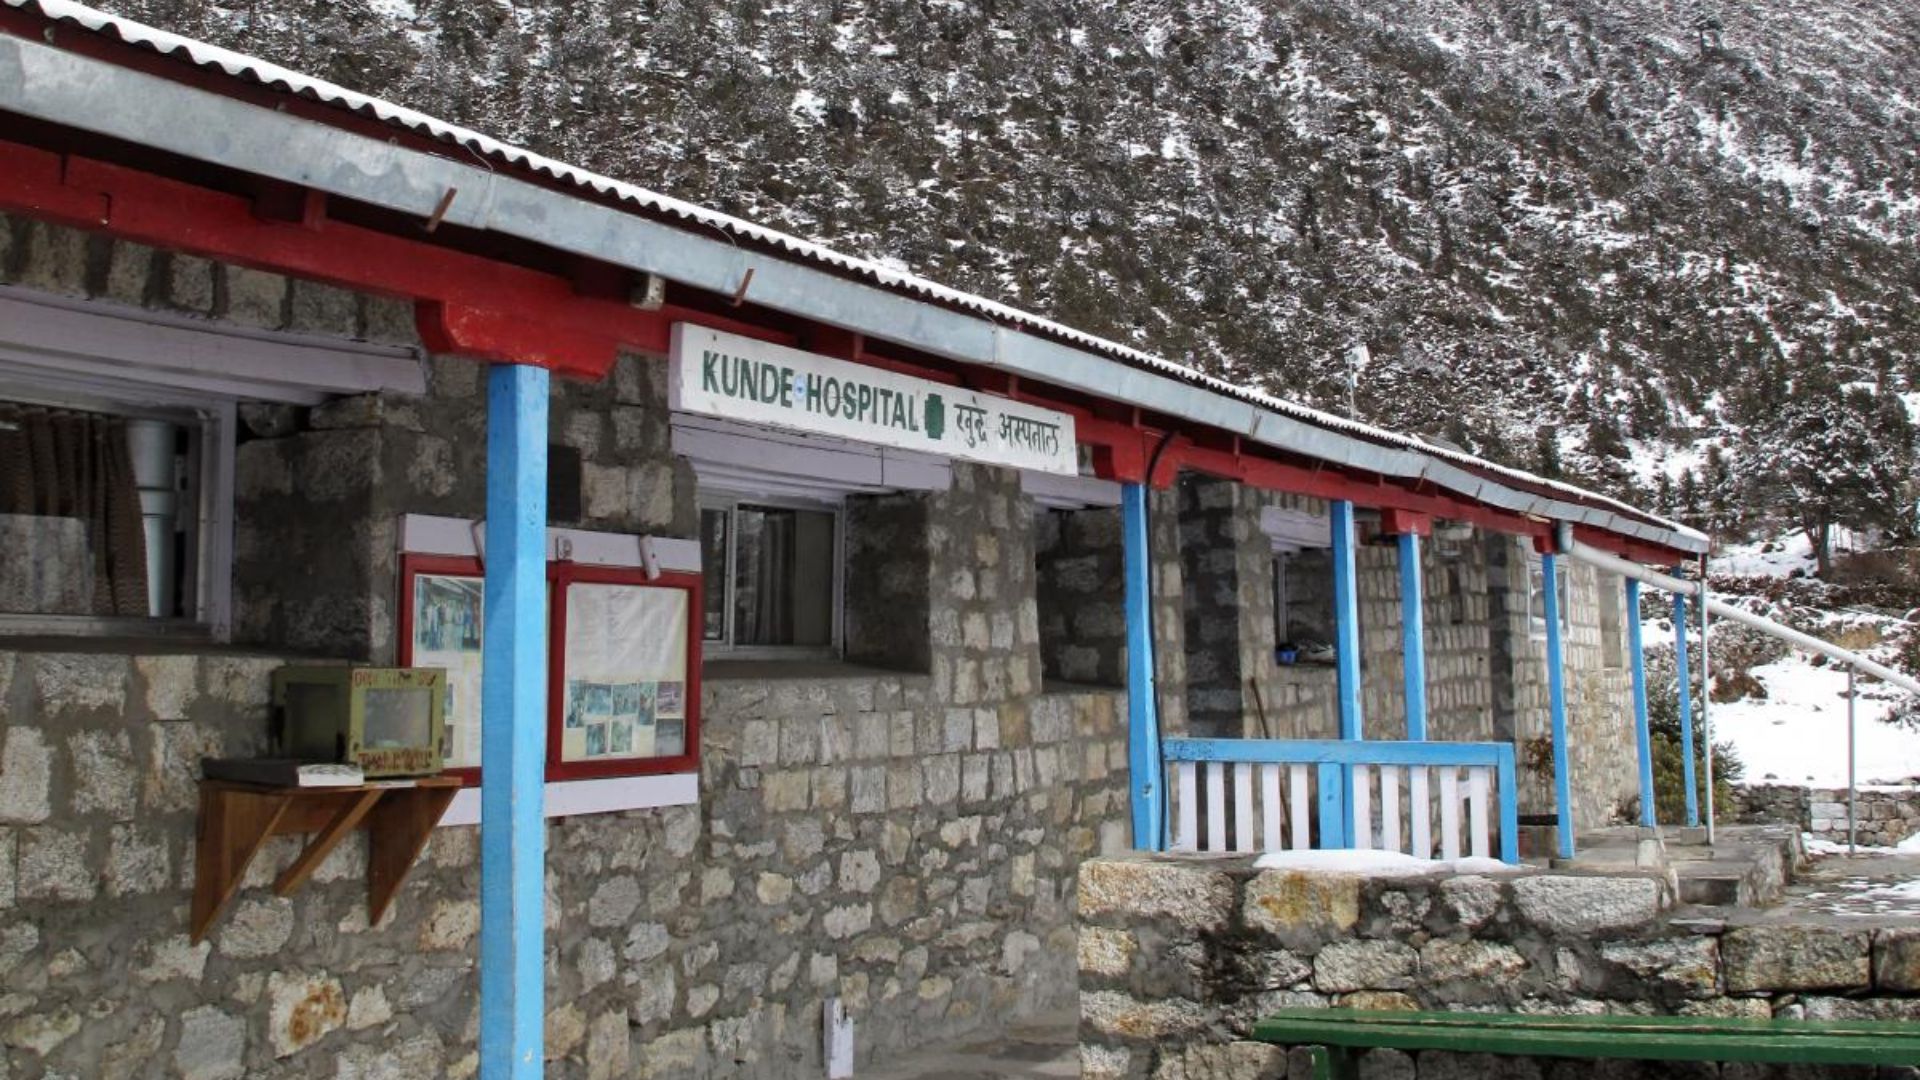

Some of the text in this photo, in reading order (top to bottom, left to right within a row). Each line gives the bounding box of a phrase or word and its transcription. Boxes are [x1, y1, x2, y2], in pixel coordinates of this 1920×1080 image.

[702, 350, 919, 432] KUNDE HOSPITAL
[999, 412, 1061, 456] अस्पताल
